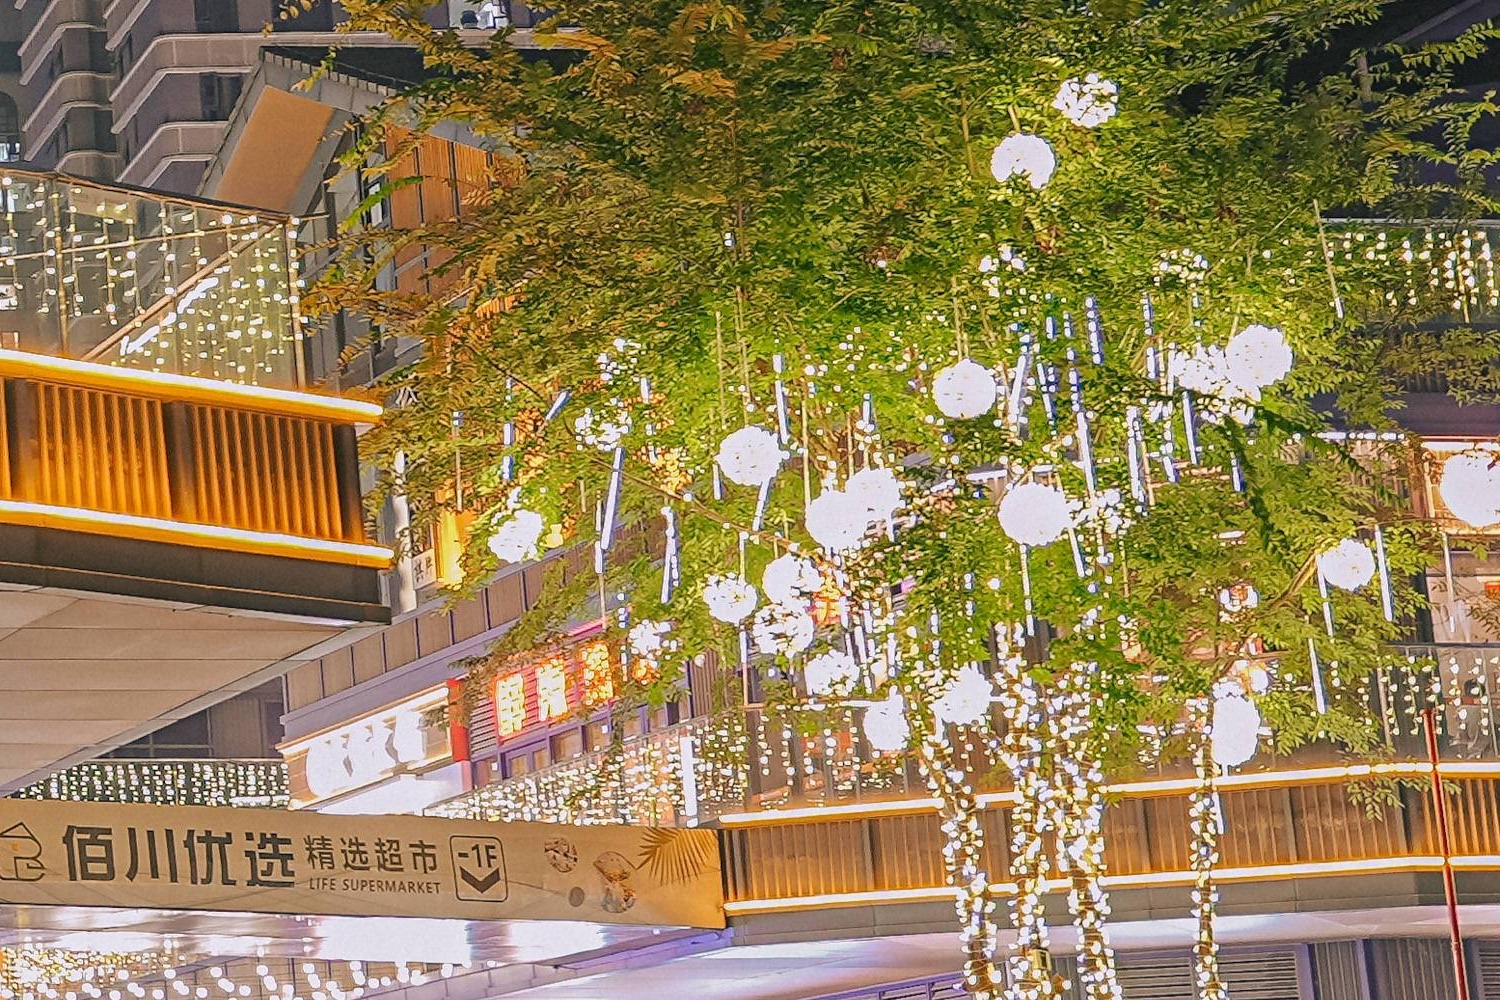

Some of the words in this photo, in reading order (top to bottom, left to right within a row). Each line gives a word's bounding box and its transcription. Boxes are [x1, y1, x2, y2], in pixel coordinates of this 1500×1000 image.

[62, 824, 296, 889] 佰川优选
[303, 834, 439, 875] 精选超市
[309, 877, 337, 892] LIFE
[341, 879, 442, 895] SUPERMARKET
